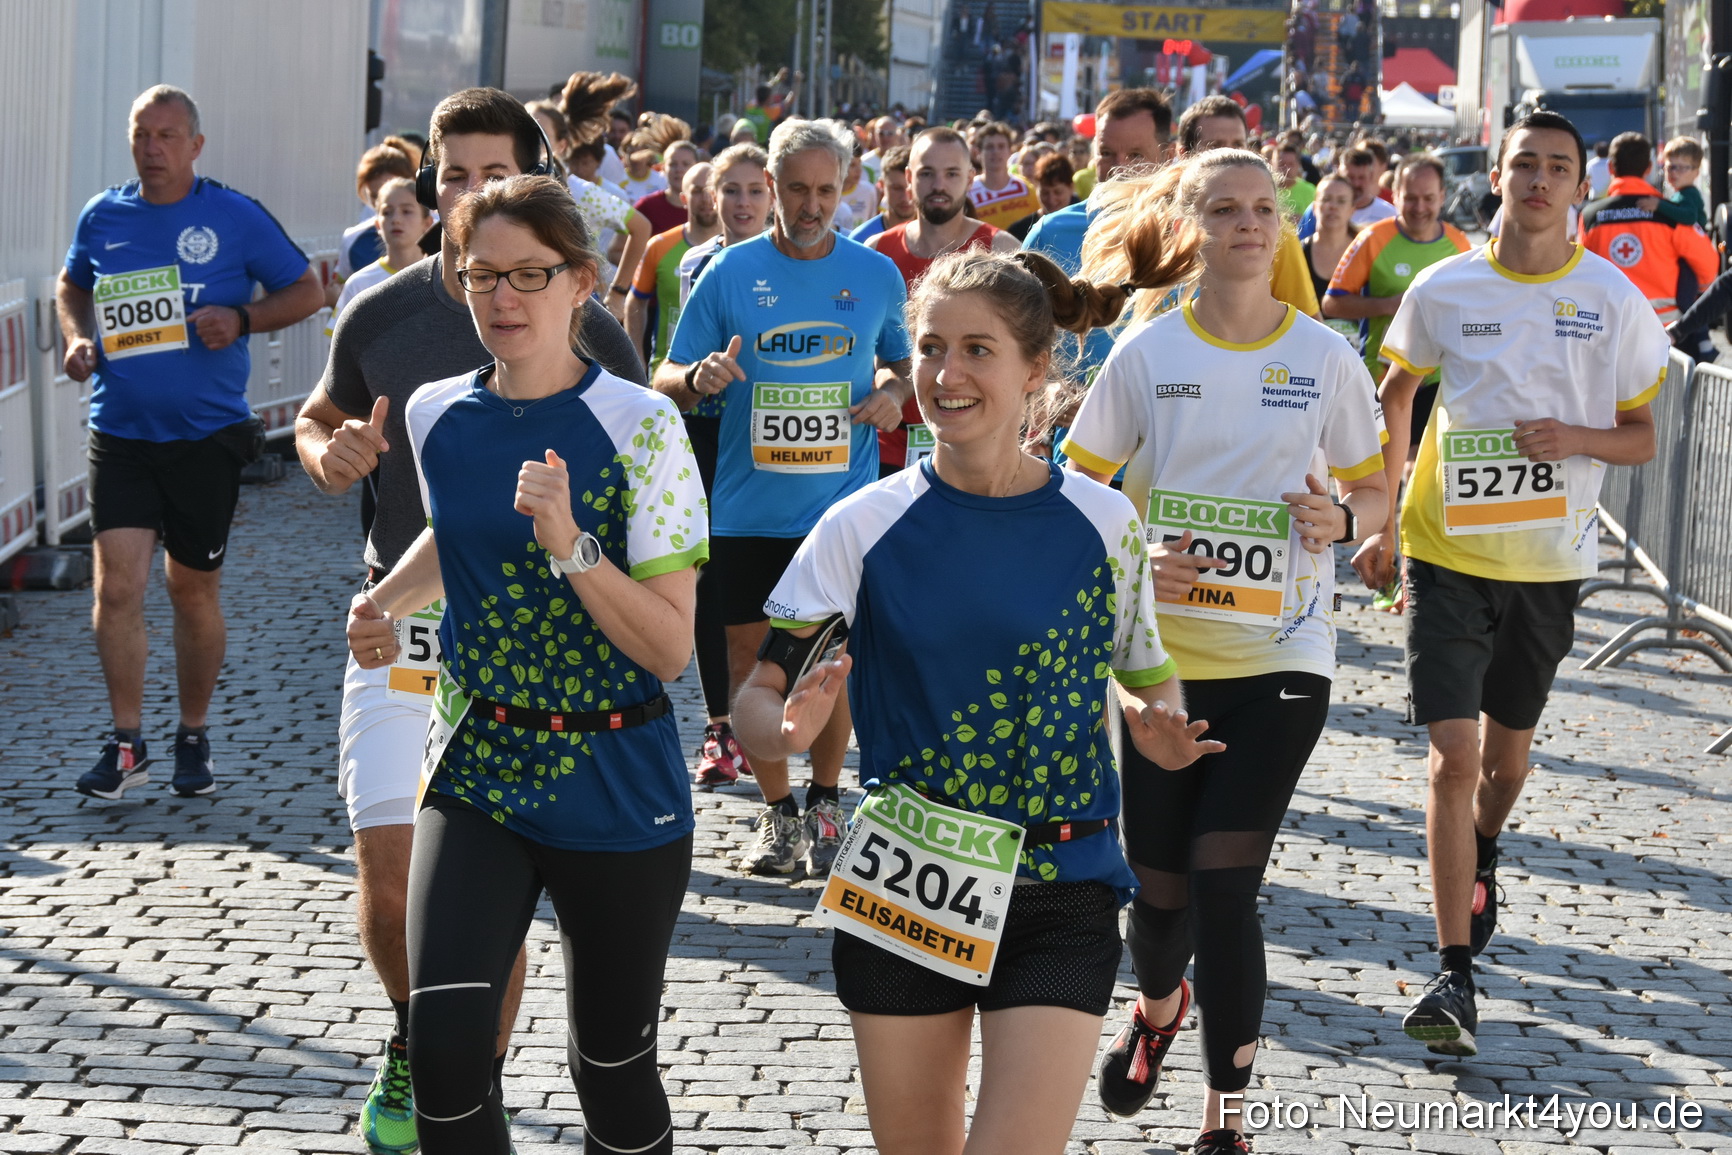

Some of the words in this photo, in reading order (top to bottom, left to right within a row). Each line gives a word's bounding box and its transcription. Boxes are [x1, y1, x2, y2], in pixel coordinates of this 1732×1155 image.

[1122, 10, 1206, 33] START
[97, 271, 172, 299] BOCK
[103, 297, 173, 331] 5080
[1556, 302, 1577, 317] 20
[1462, 324, 1501, 334] BOCK
[1555, 319, 1604, 332] Neumarkter
[117, 331, 162, 348] HORST
[757, 333, 854, 356] LAUF10!
[1555, 329, 1593, 342] Stadtlauf
[1263, 368, 1289, 385] 20
[1291, 377, 1313, 386] JAHRE
[760, 386, 843, 407] BOCK
[1156, 384, 1201, 395] BOCK
[1262, 386, 1321, 399] Neumarkter
[1261, 399, 1310, 411] Stadtlauf
[763, 414, 840, 442] 5093
[771, 450, 833, 462] HELMUT
[1458, 462, 1554, 498] 5278
[1158, 494, 1279, 535] BOCK
[1276, 549, 1283, 557] S
[1188, 586, 1236, 607] TINA
[869, 785, 1007, 865] BOCK
[851, 832, 983, 926] 5204
[993, 886, 1002, 895] S
[839, 888, 976, 962] ELISABETH
